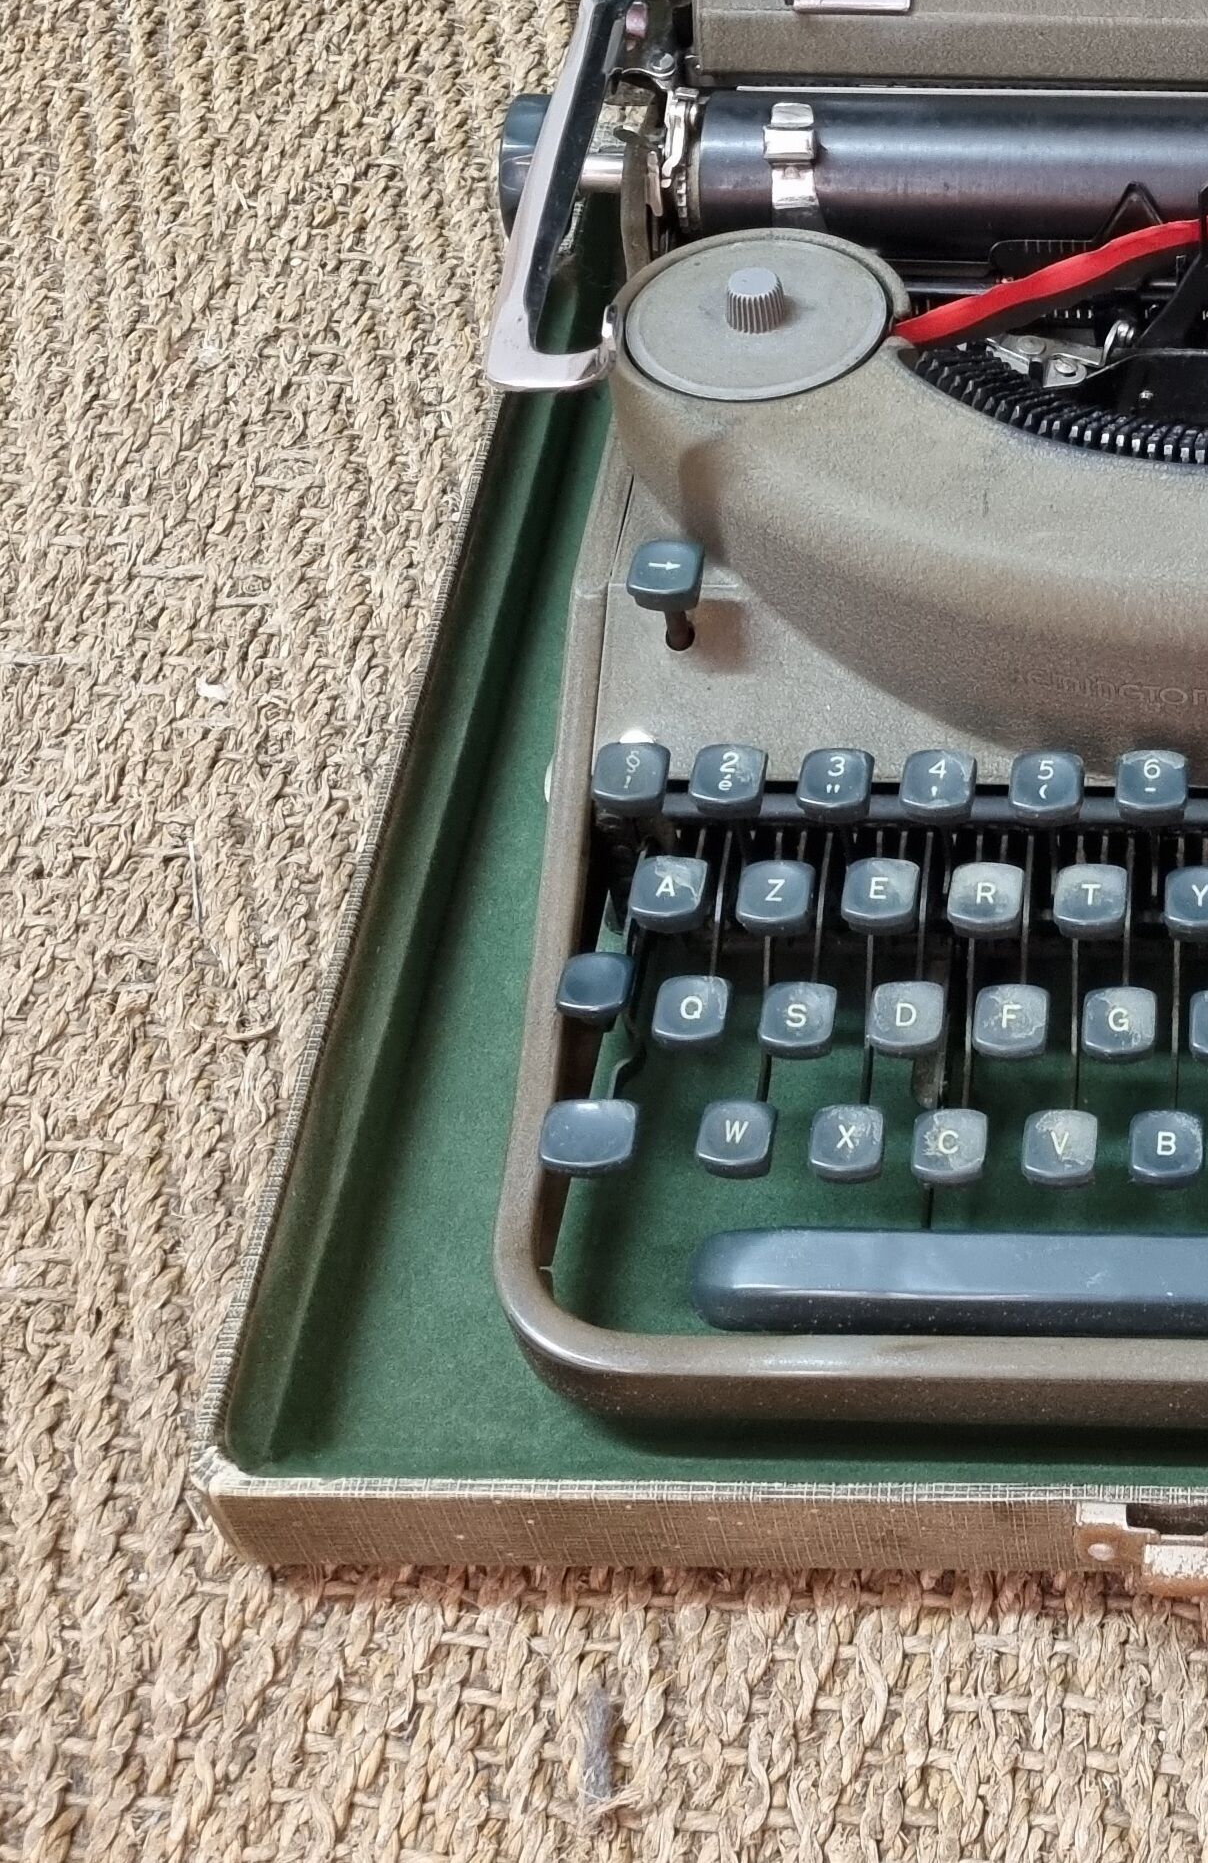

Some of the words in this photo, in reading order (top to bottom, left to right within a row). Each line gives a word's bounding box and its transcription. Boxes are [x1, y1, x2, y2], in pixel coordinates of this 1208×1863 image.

[720, 751, 741, 773] 2
[827, 755, 846, 777] 3
[928, 758, 948, 779] 4
[1037, 759, 1054, 780] 5
[1143, 758, 1161, 780] 6
[655, 877, 676, 898] A
[764, 878, 786, 902] Z
[869, 877, 888, 900] E
[976, 882, 996, 905] R
[1081, 883, 1102, 906] T
[679, 995, 703, 1020] Q
[785, 1003, 808, 1029] S
[894, 1002, 918, 1028] D
[1001, 1004, 1023, 1030] F
[1108, 1007, 1129, 1032] G
[725, 1120, 749, 1143] W
[836, 1124, 856, 1149] X
[938, 1131, 959, 1154] C
[1050, 1131, 1070, 1156] V
[1156, 1131, 1177, 1156] B
